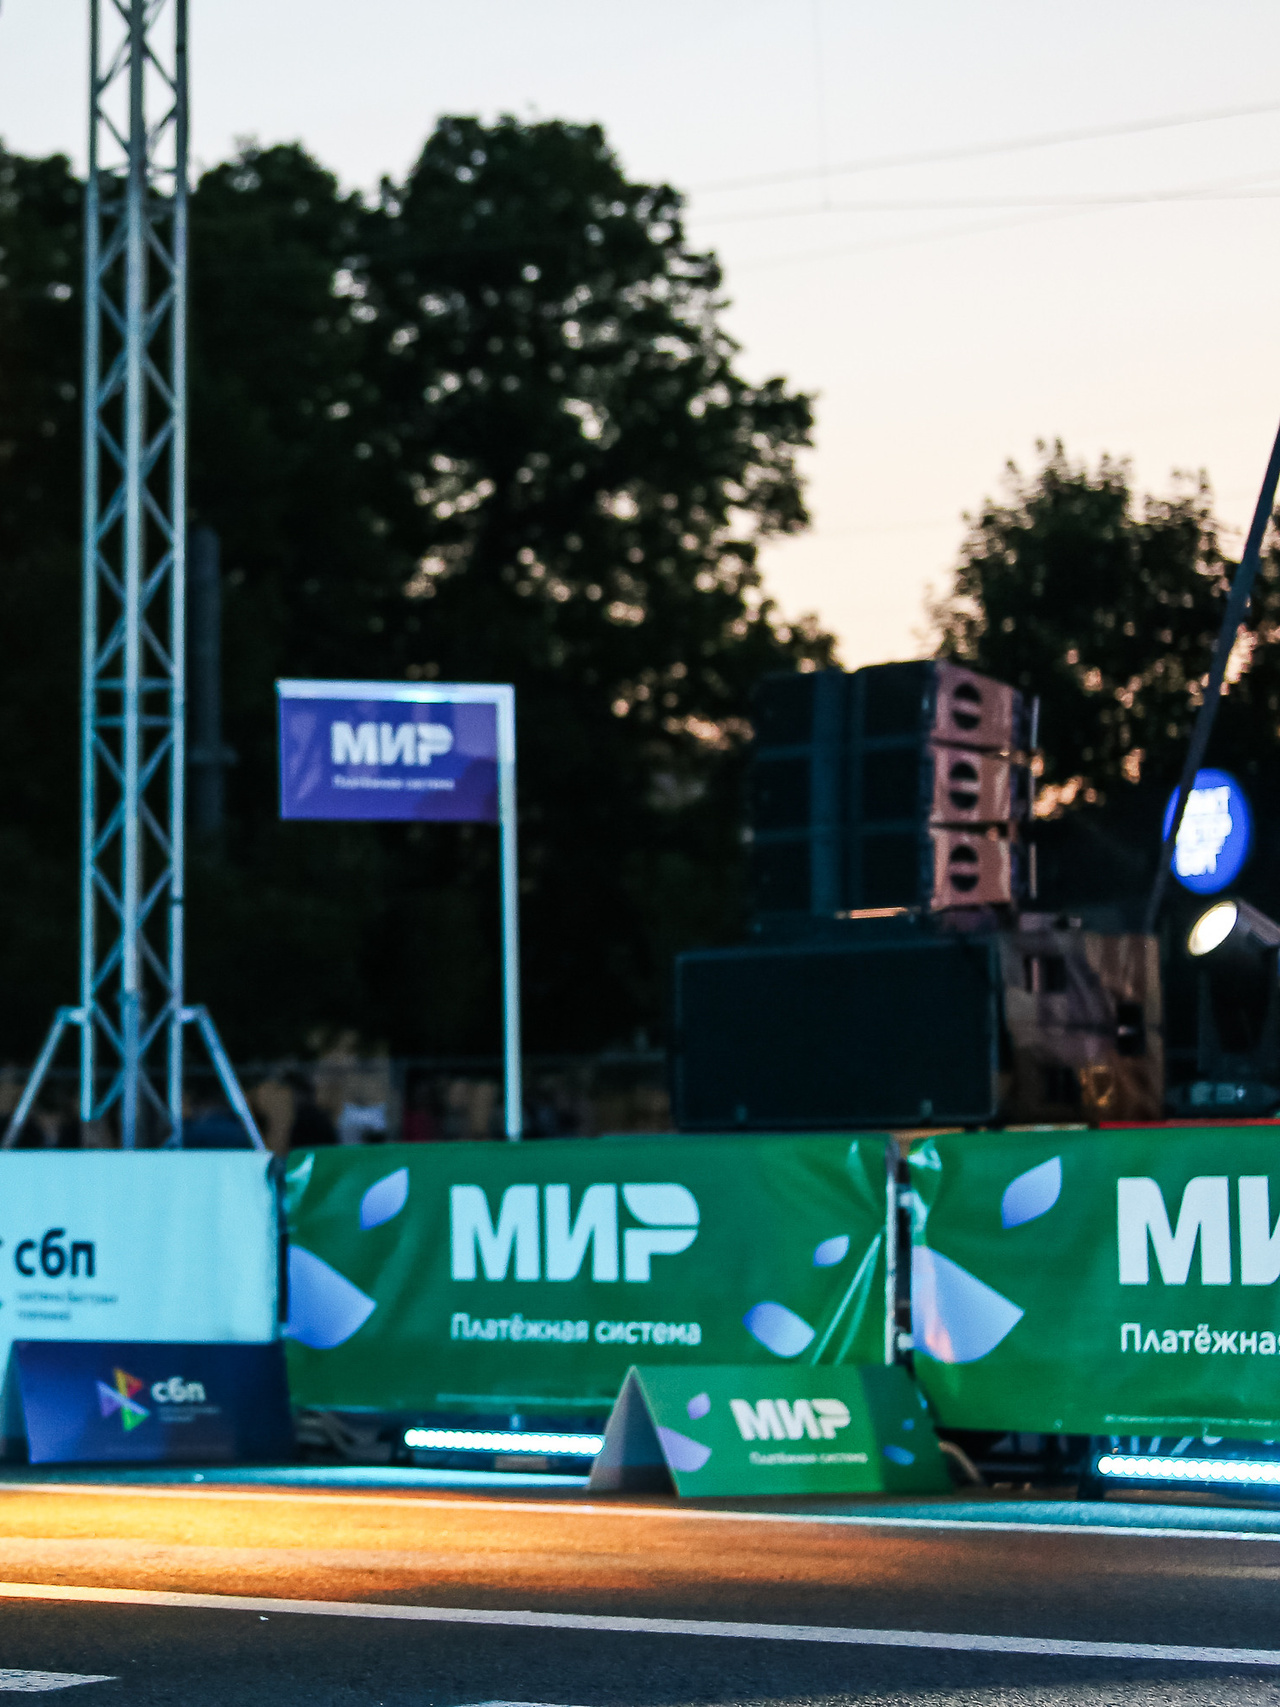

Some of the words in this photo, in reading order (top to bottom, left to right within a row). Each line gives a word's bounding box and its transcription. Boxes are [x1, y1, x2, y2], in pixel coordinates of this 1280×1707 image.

[331, 721, 453, 766] МИР
[14, 1227, 95, 1278] сбп
[450, 1183, 701, 1283] МИР
[450, 1312, 590, 1343] Платёжная
[594, 1320, 702, 1346] система
[729, 1398, 851, 1441] МИР
